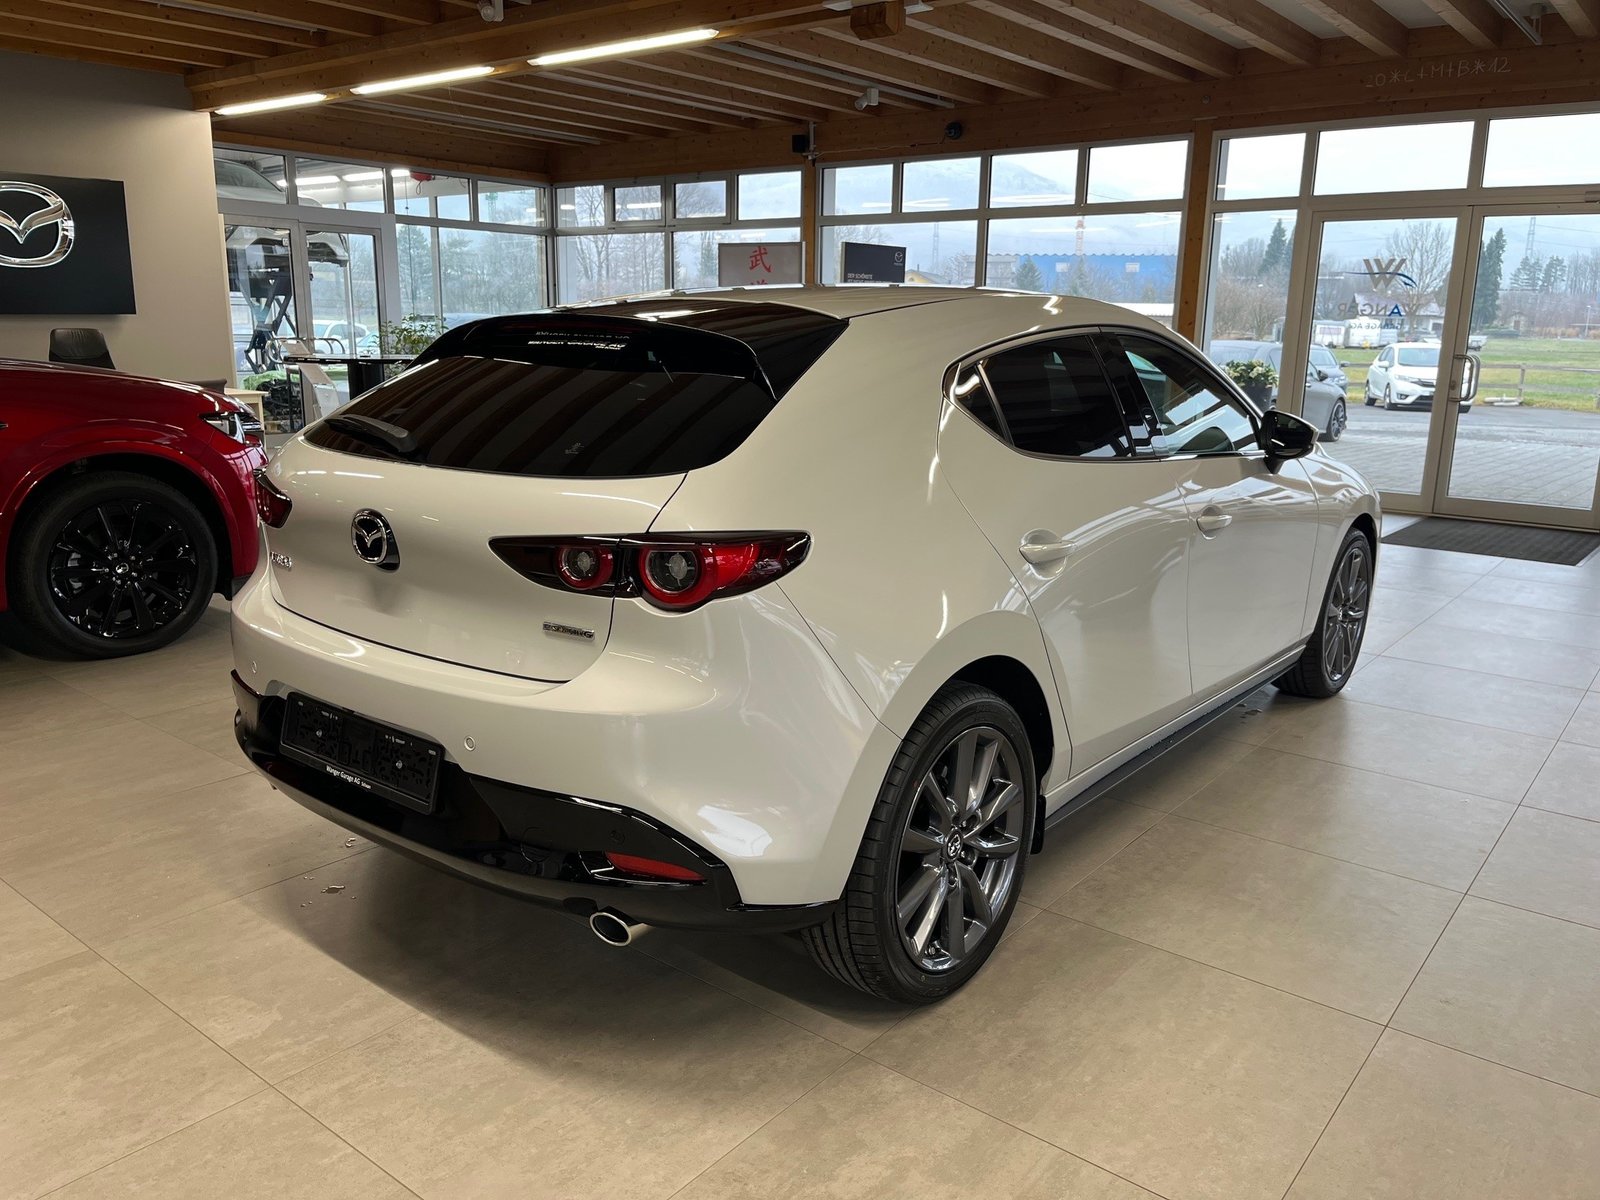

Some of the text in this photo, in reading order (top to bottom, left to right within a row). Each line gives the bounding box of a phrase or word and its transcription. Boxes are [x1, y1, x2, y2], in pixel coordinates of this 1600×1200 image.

[326, 764, 340, 776] Wanger
[340, 771, 354, 782] Garage
[353, 777, 361, 785] AG
